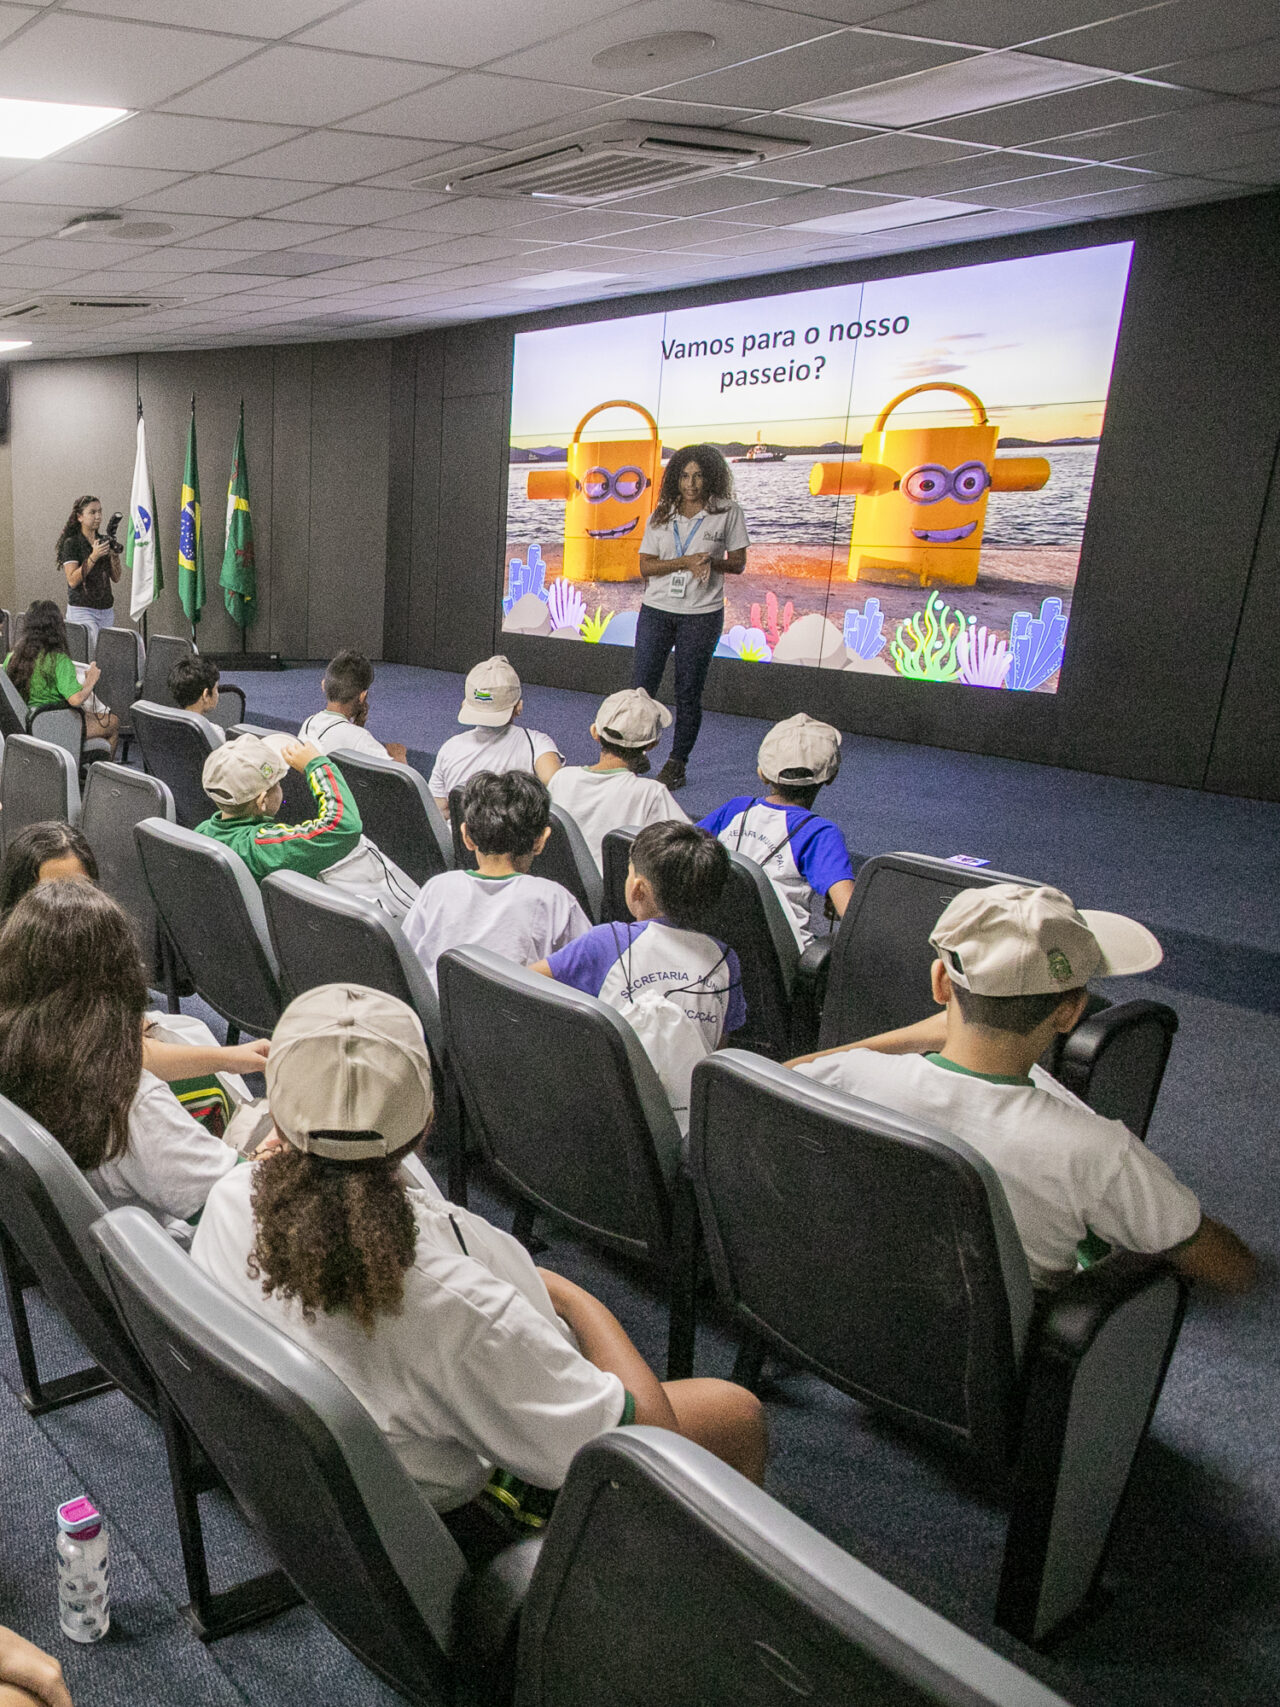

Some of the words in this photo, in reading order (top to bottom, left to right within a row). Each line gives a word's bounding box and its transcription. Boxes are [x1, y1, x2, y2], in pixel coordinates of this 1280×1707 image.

[661, 336, 734, 360] Vamos
[742, 329, 796, 357] para
[804, 326, 820, 344] o
[829, 315, 910, 342] nosso
[720, 355, 826, 393] passeio?
[620, 971, 690, 999] SECRETARIA
